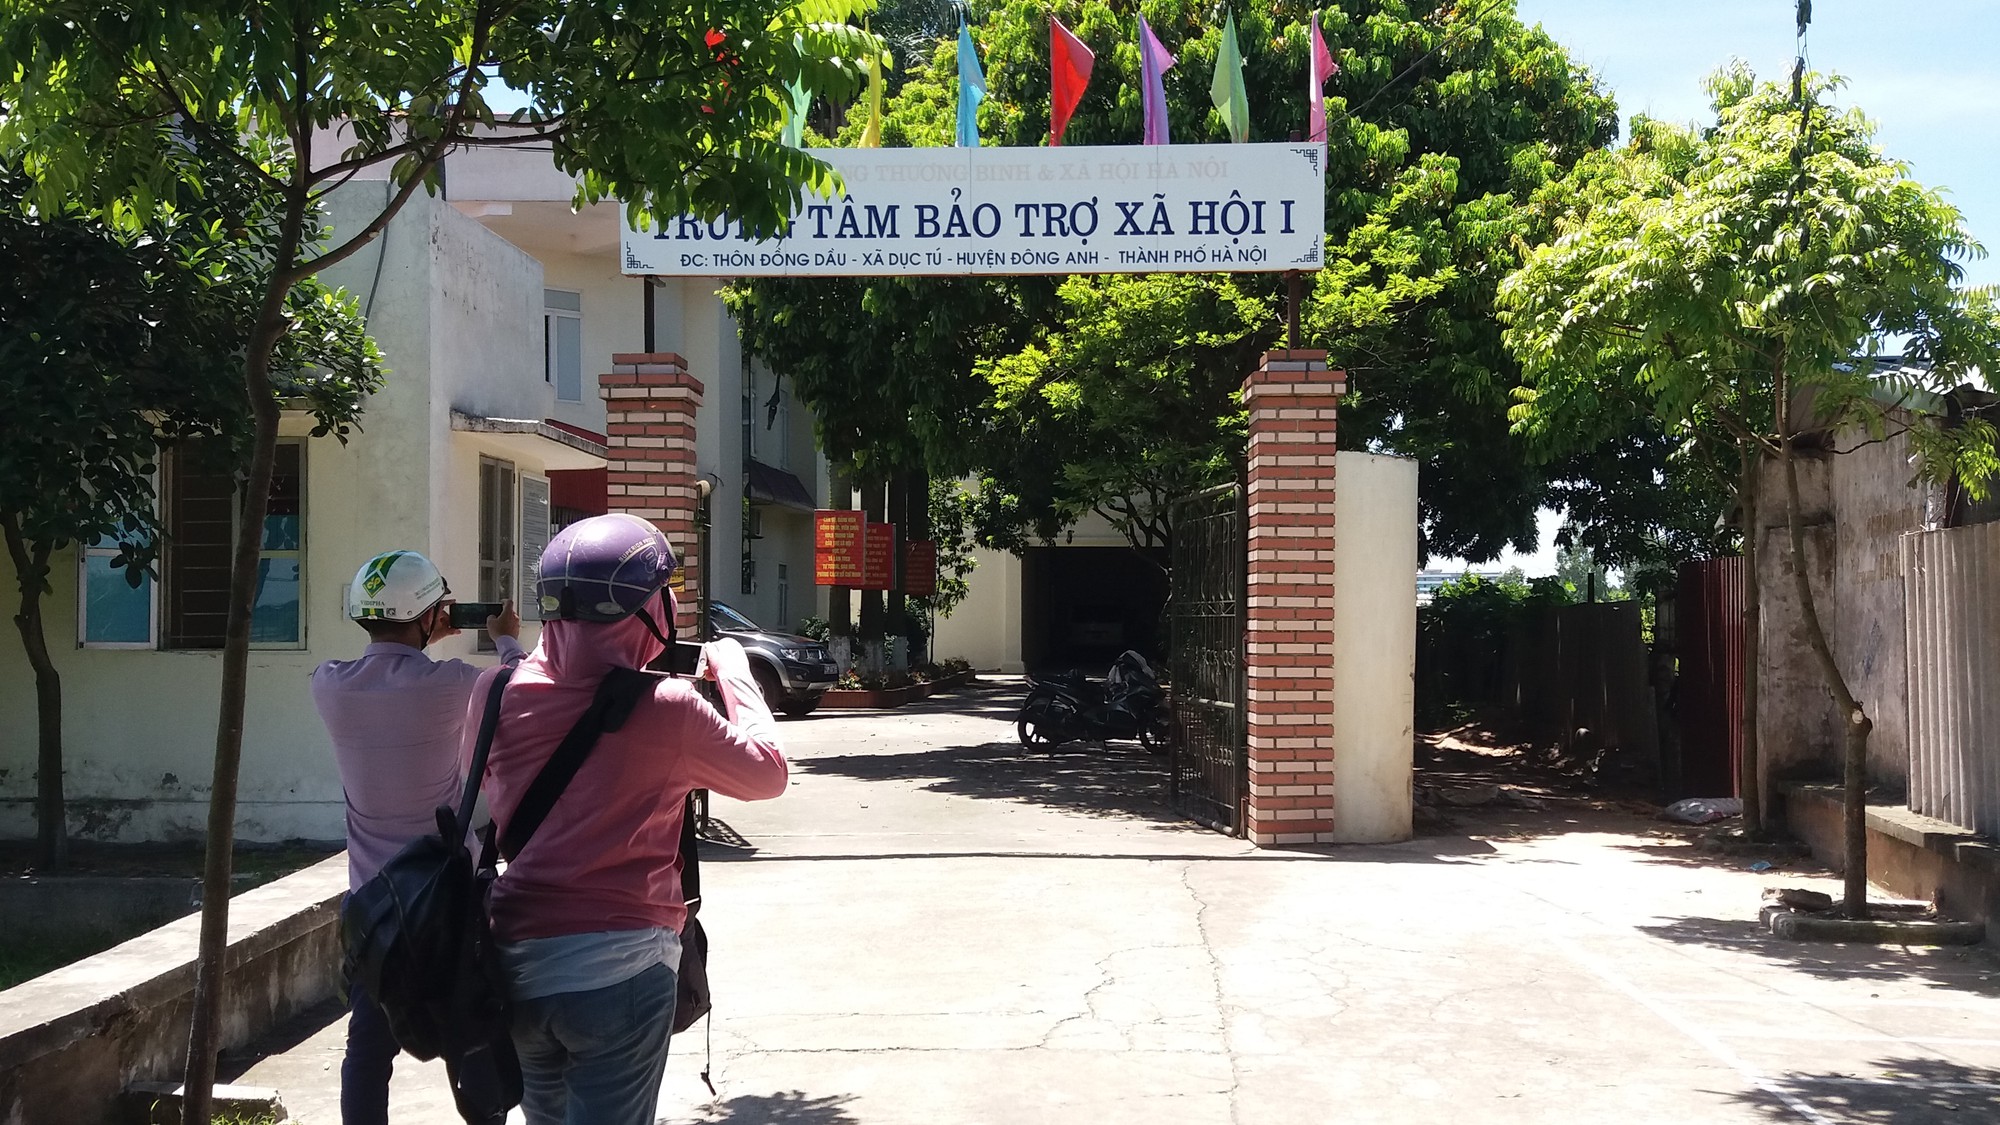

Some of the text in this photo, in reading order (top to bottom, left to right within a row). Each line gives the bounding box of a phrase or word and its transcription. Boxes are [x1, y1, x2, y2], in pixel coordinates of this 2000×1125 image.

[976, 164, 1031, 182] BINH
[1038, 164, 1054, 181] &
[1059, 158, 1091, 180] XÃ
[1098, 157, 1140, 184] HỘI
[1146, 156, 1179, 180] HÀ
[1187, 155, 1229, 182] NỘI
[808, 188, 901, 239] TÂM
[914, 188, 1002, 239] BẢO
[1015, 196, 1098, 246] TRỢ
[1114, 192, 1175, 236] XÃ
[1188, 190, 1267, 245] HỘI
[1280, 200, 1296, 234] I
[680, 253, 708, 267] ĐC:
[713, 250, 755, 267] THÔN
[760, 247, 810, 267] ĐỒNG
[815, 248, 847, 267] DẦU
[862, 249, 885, 266] XÃ
[889, 252, 921, 269] DỤC
[925, 248, 942, 266] TÚ
[957, 249, 1006, 269] HUYỆN
[1010, 249, 1060, 266] ĐÔNG
[1065, 251, 1099, 265] ANH
[1119, 246, 1169, 264] THÀNH
[1174, 245, 1207, 263] PHỐ
[1212, 245, 1234, 263] HÀ
[1239, 245, 1267, 264] NỘI
